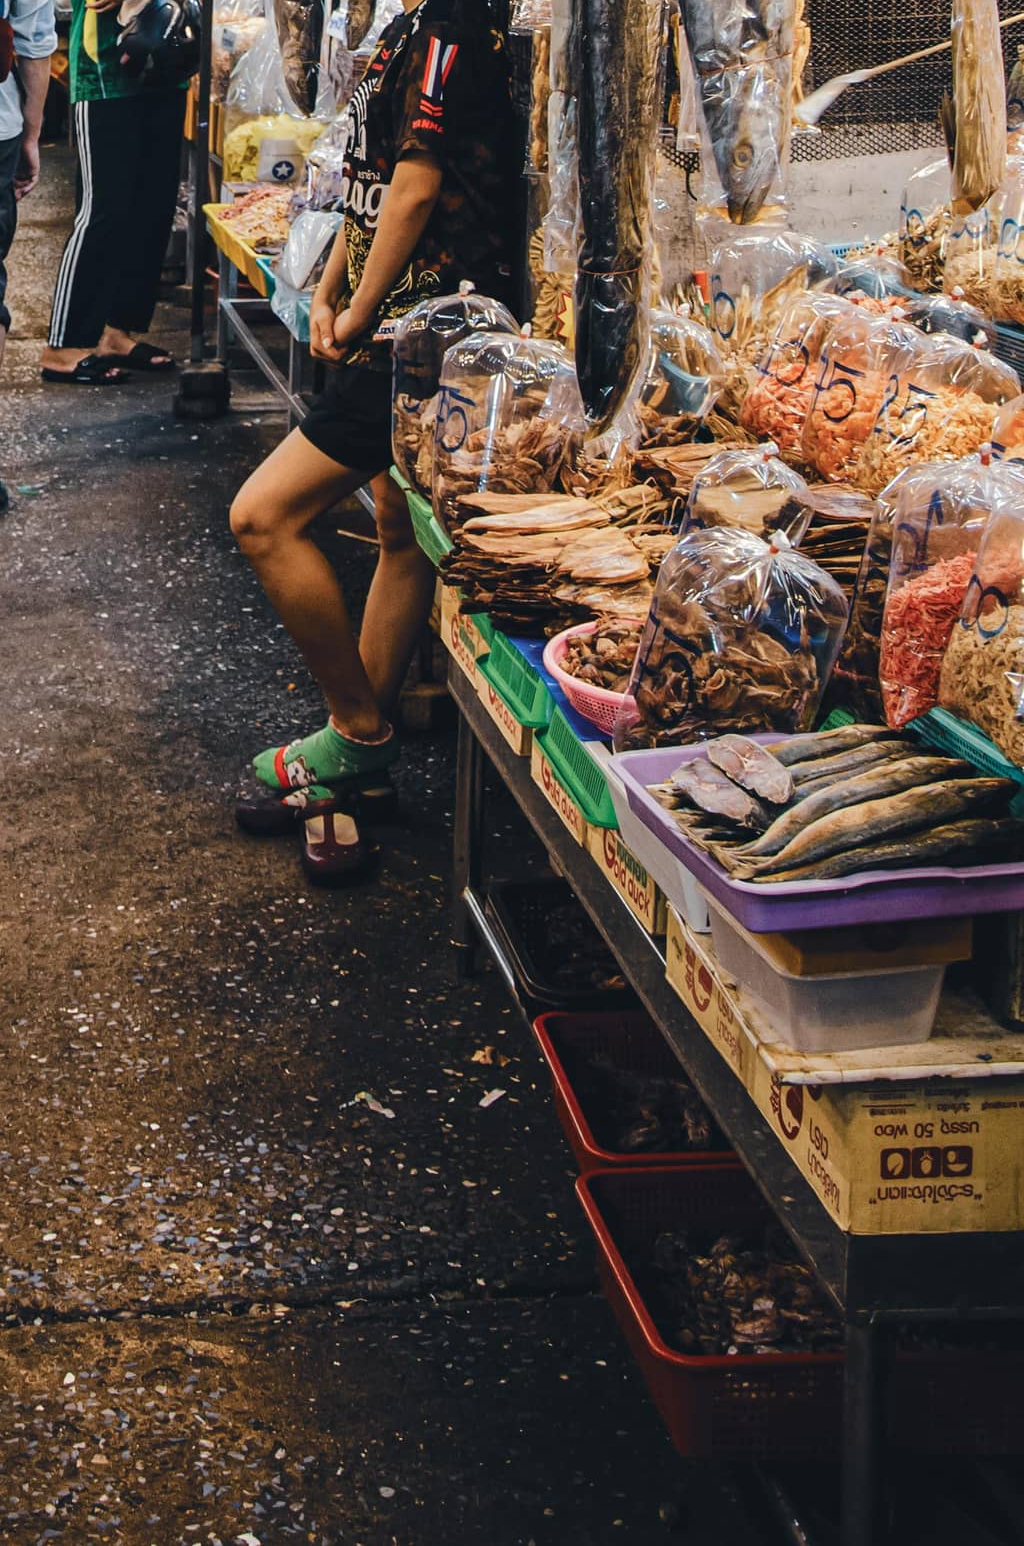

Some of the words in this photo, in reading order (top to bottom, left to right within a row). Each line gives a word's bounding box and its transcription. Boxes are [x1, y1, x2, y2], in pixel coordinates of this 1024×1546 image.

[627, 871, 651, 918] duck
[914, 1122, 934, 1138] 50
[940, 1118, 980, 1135] บรรจุ
